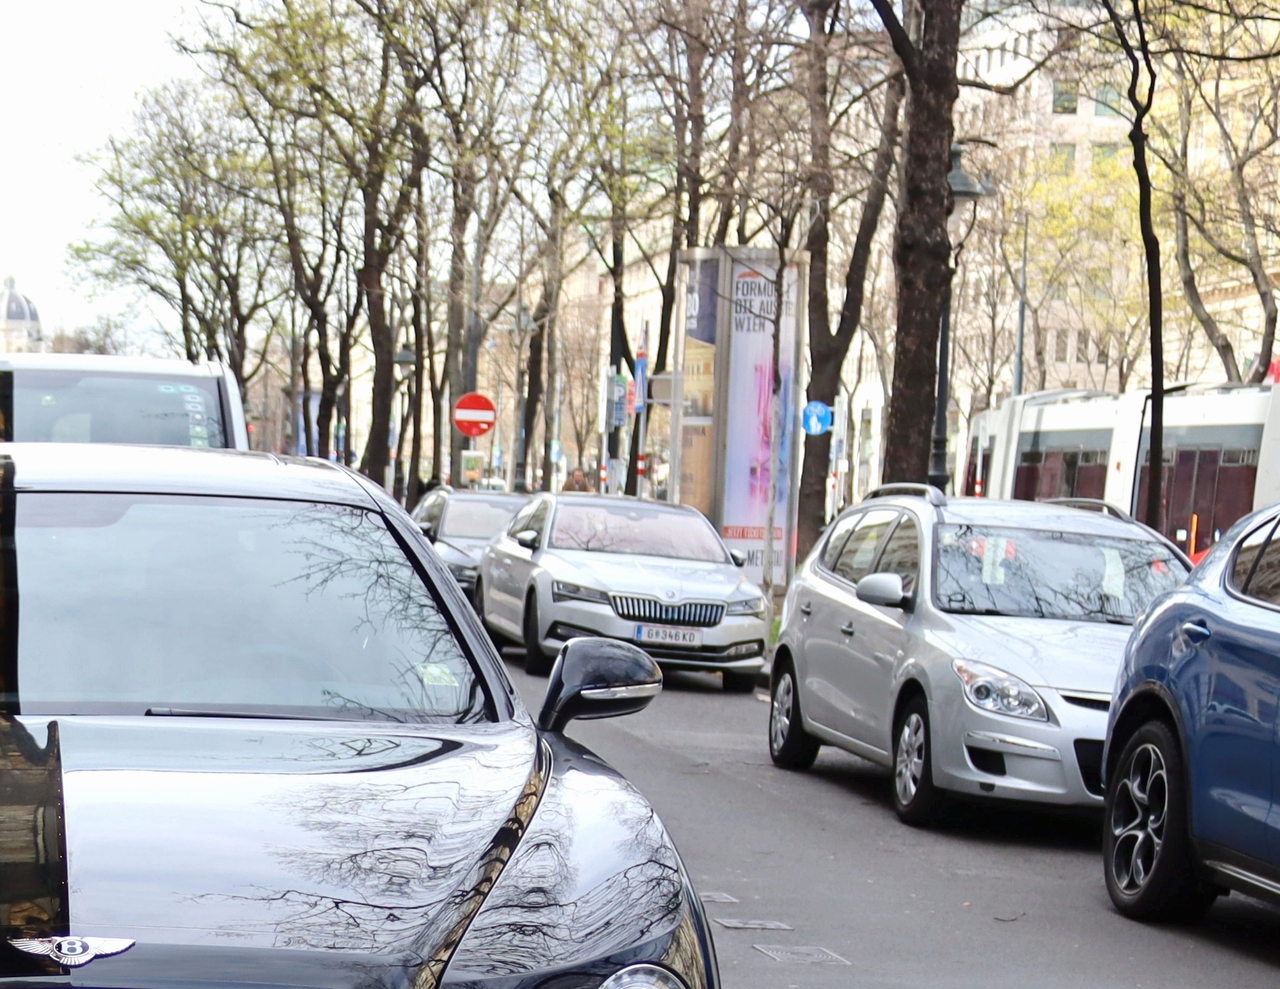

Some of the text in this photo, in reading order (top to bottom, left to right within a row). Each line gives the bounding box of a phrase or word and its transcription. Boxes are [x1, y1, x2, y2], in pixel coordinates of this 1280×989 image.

[736, 281, 783, 298] FORMU
[735, 298, 754, 314] DIE
[735, 315, 766, 332] WIEN
[647, 629, 654, 639] G
